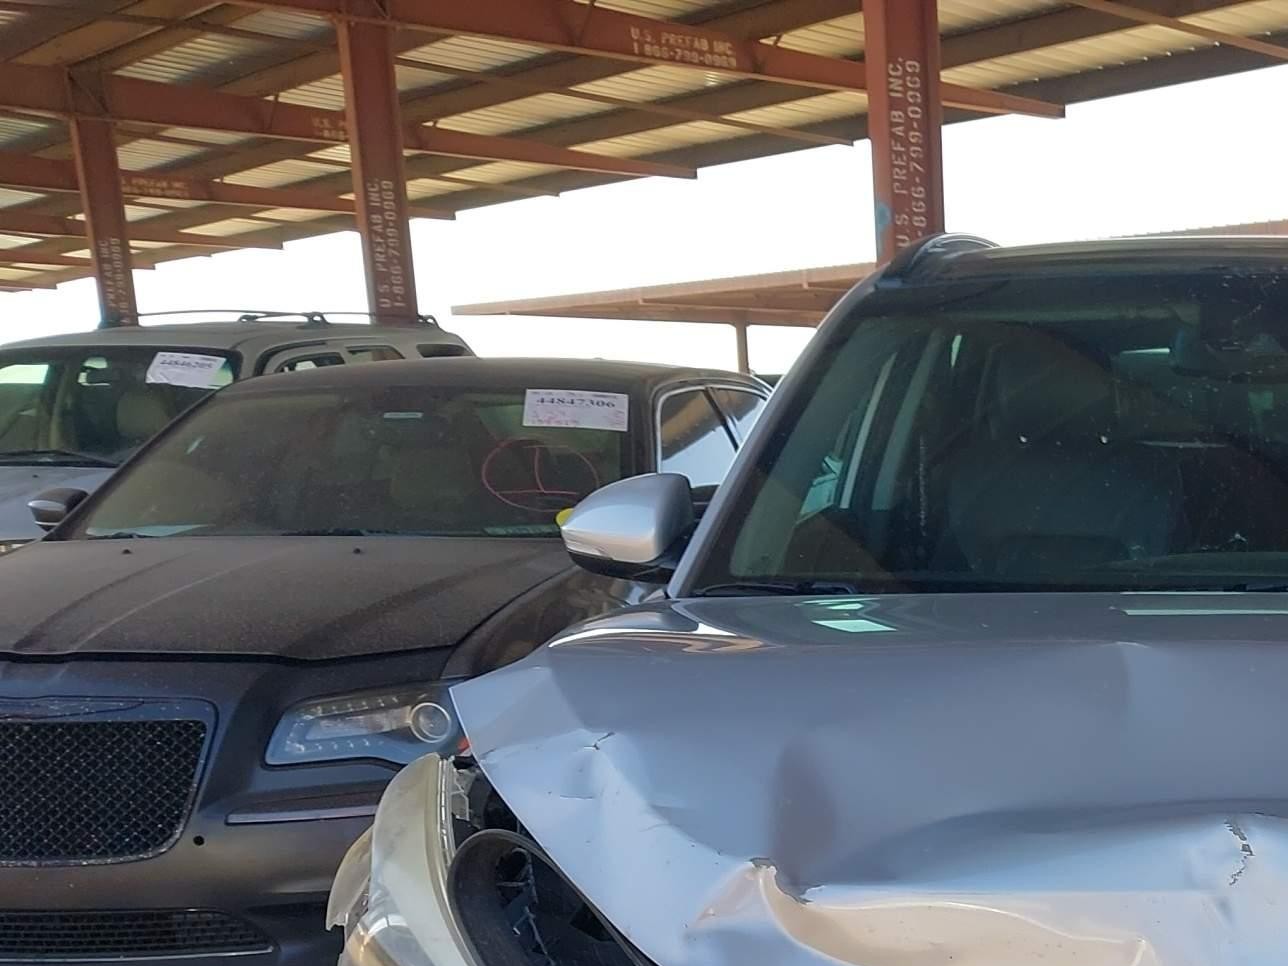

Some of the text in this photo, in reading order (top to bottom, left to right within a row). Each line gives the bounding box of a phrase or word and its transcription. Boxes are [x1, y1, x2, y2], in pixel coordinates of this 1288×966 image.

[660, 31, 709, 51] PREFAB
[888, 57, 911, 248] U.S. PREFAB INC.
[905, 59, 927, 238] -866-799-0969
[370, 213, 388, 272] PREFAB
